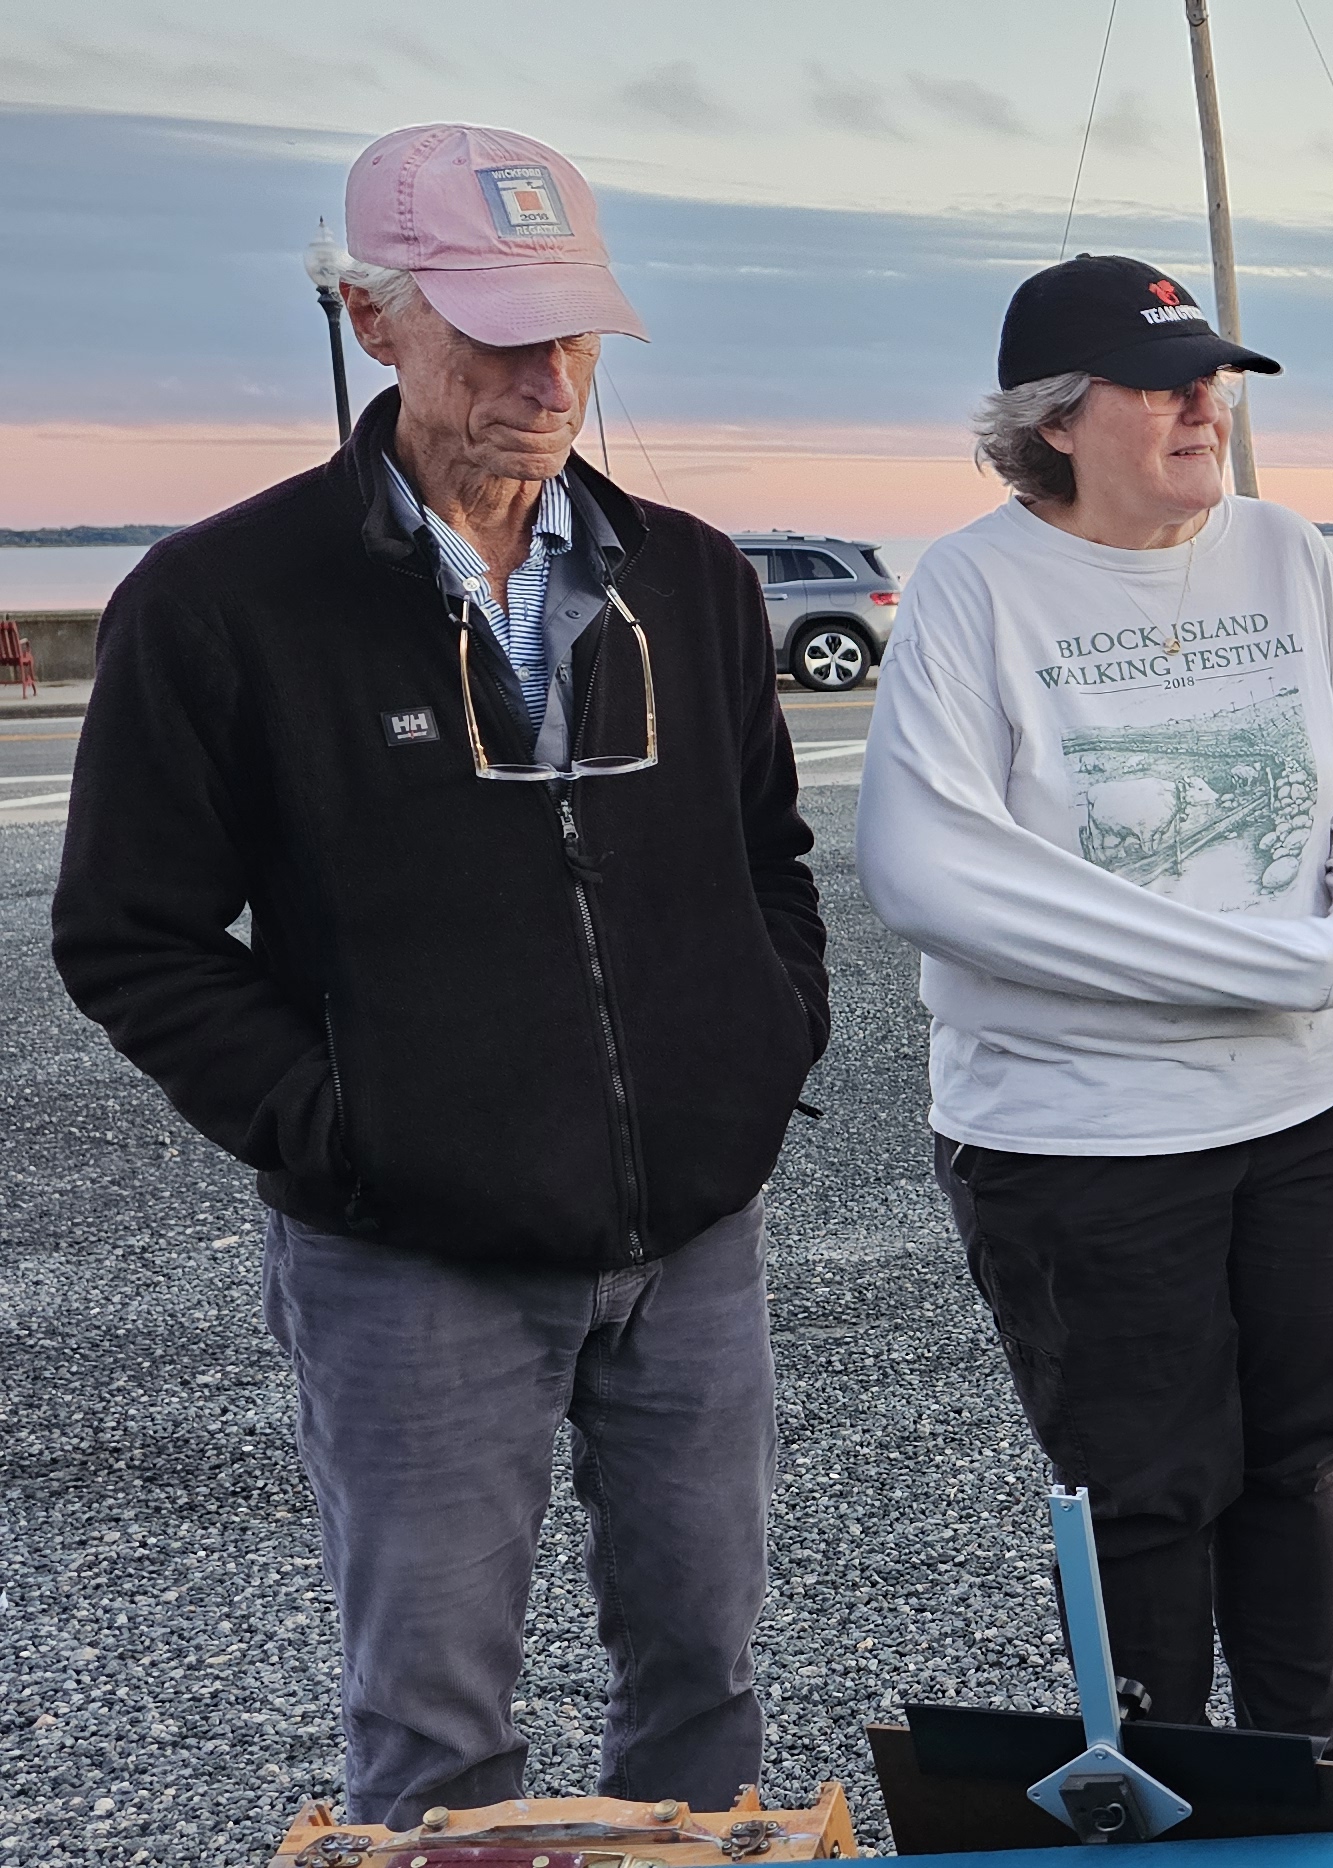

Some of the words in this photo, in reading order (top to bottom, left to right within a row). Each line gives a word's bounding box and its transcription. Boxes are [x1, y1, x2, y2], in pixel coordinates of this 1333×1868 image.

[492, 169, 541, 179] WICKFORD
[516, 226, 561, 236] REGATTA
[1056, 626, 1160, 660] BLOCK
[1171, 613, 1269, 644] ISLAND
[1035, 656, 1172, 690] WALKING
[1181, 634, 1304, 673] FESTIVAL
[1163, 677, 1195, 691] 2018
[391, 713, 428, 733] HH
